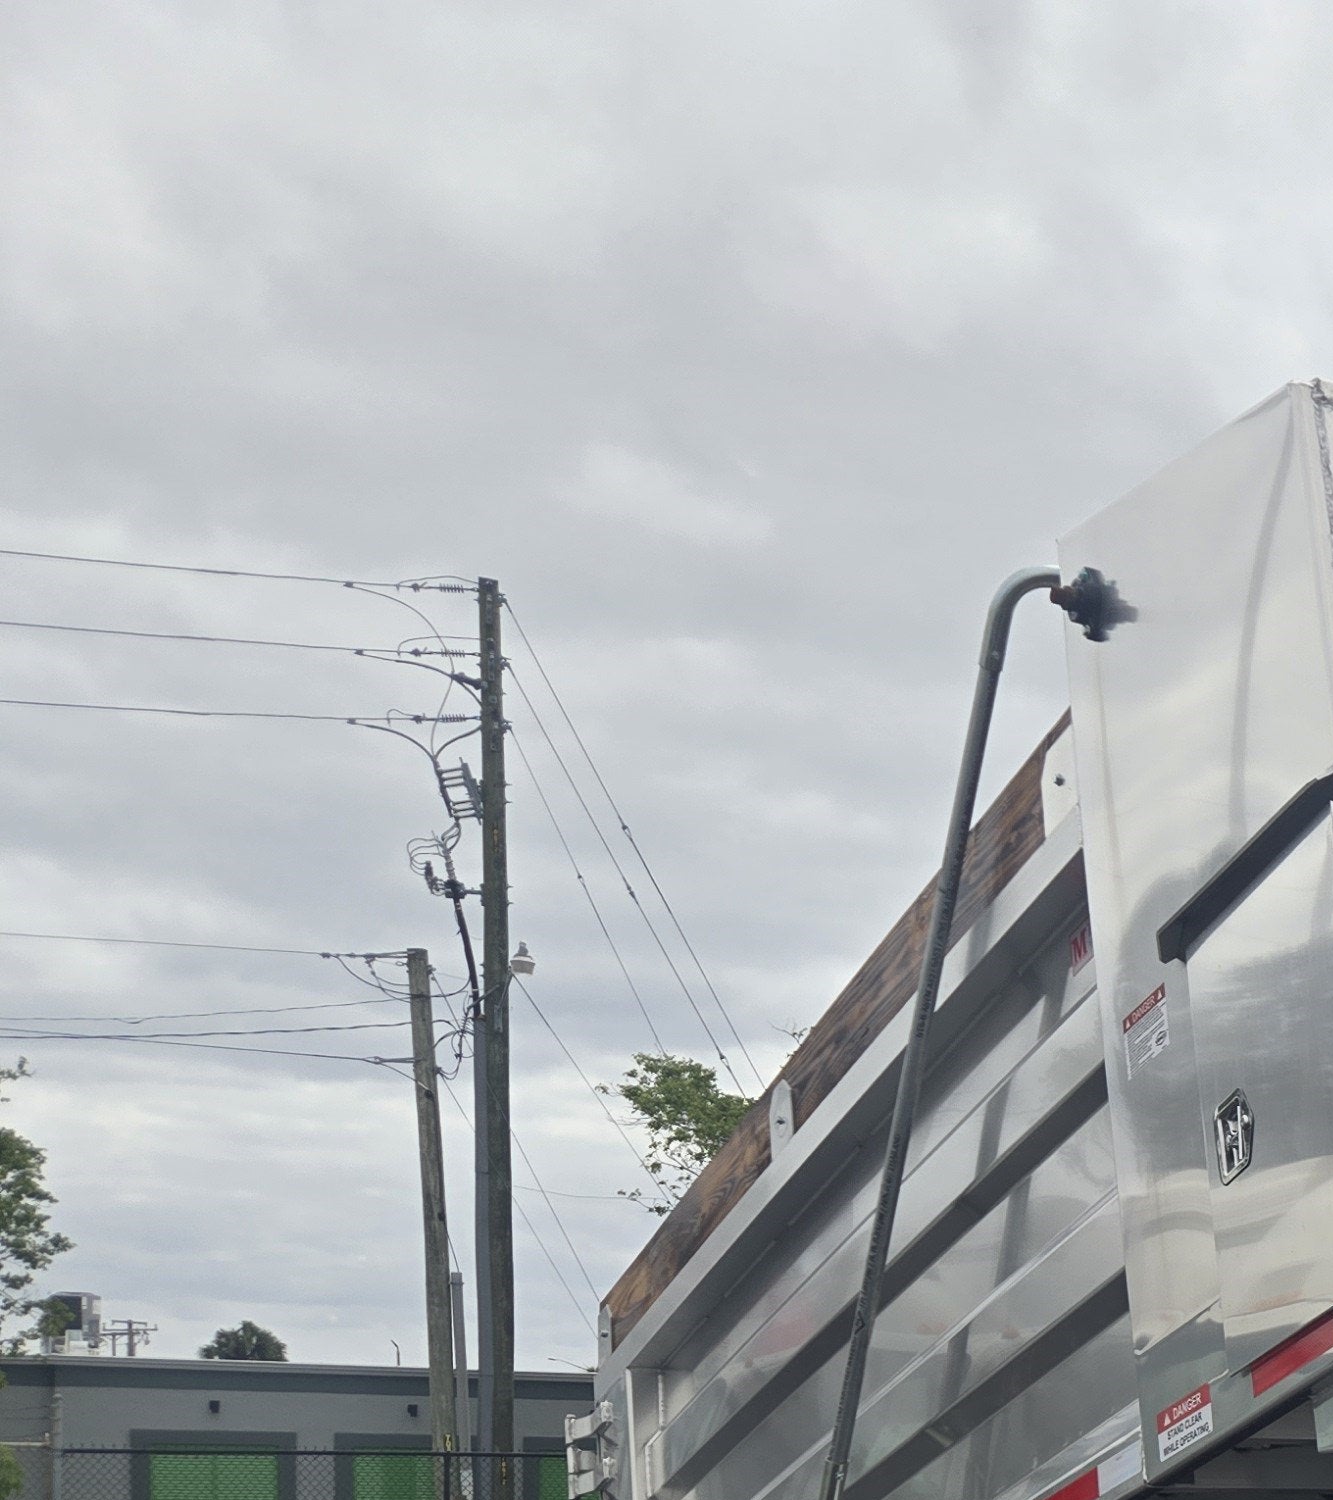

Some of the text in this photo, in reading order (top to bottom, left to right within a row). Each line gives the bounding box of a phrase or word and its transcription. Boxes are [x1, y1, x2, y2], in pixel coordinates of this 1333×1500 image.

[1131, 995, 1157, 1023] DANGER
[1172, 1391, 1202, 1421] DANGER
[1163, 1421, 1210, 1456] WHILE OPERATING
[1167, 1411, 1203, 1440] STAND CLEAR
